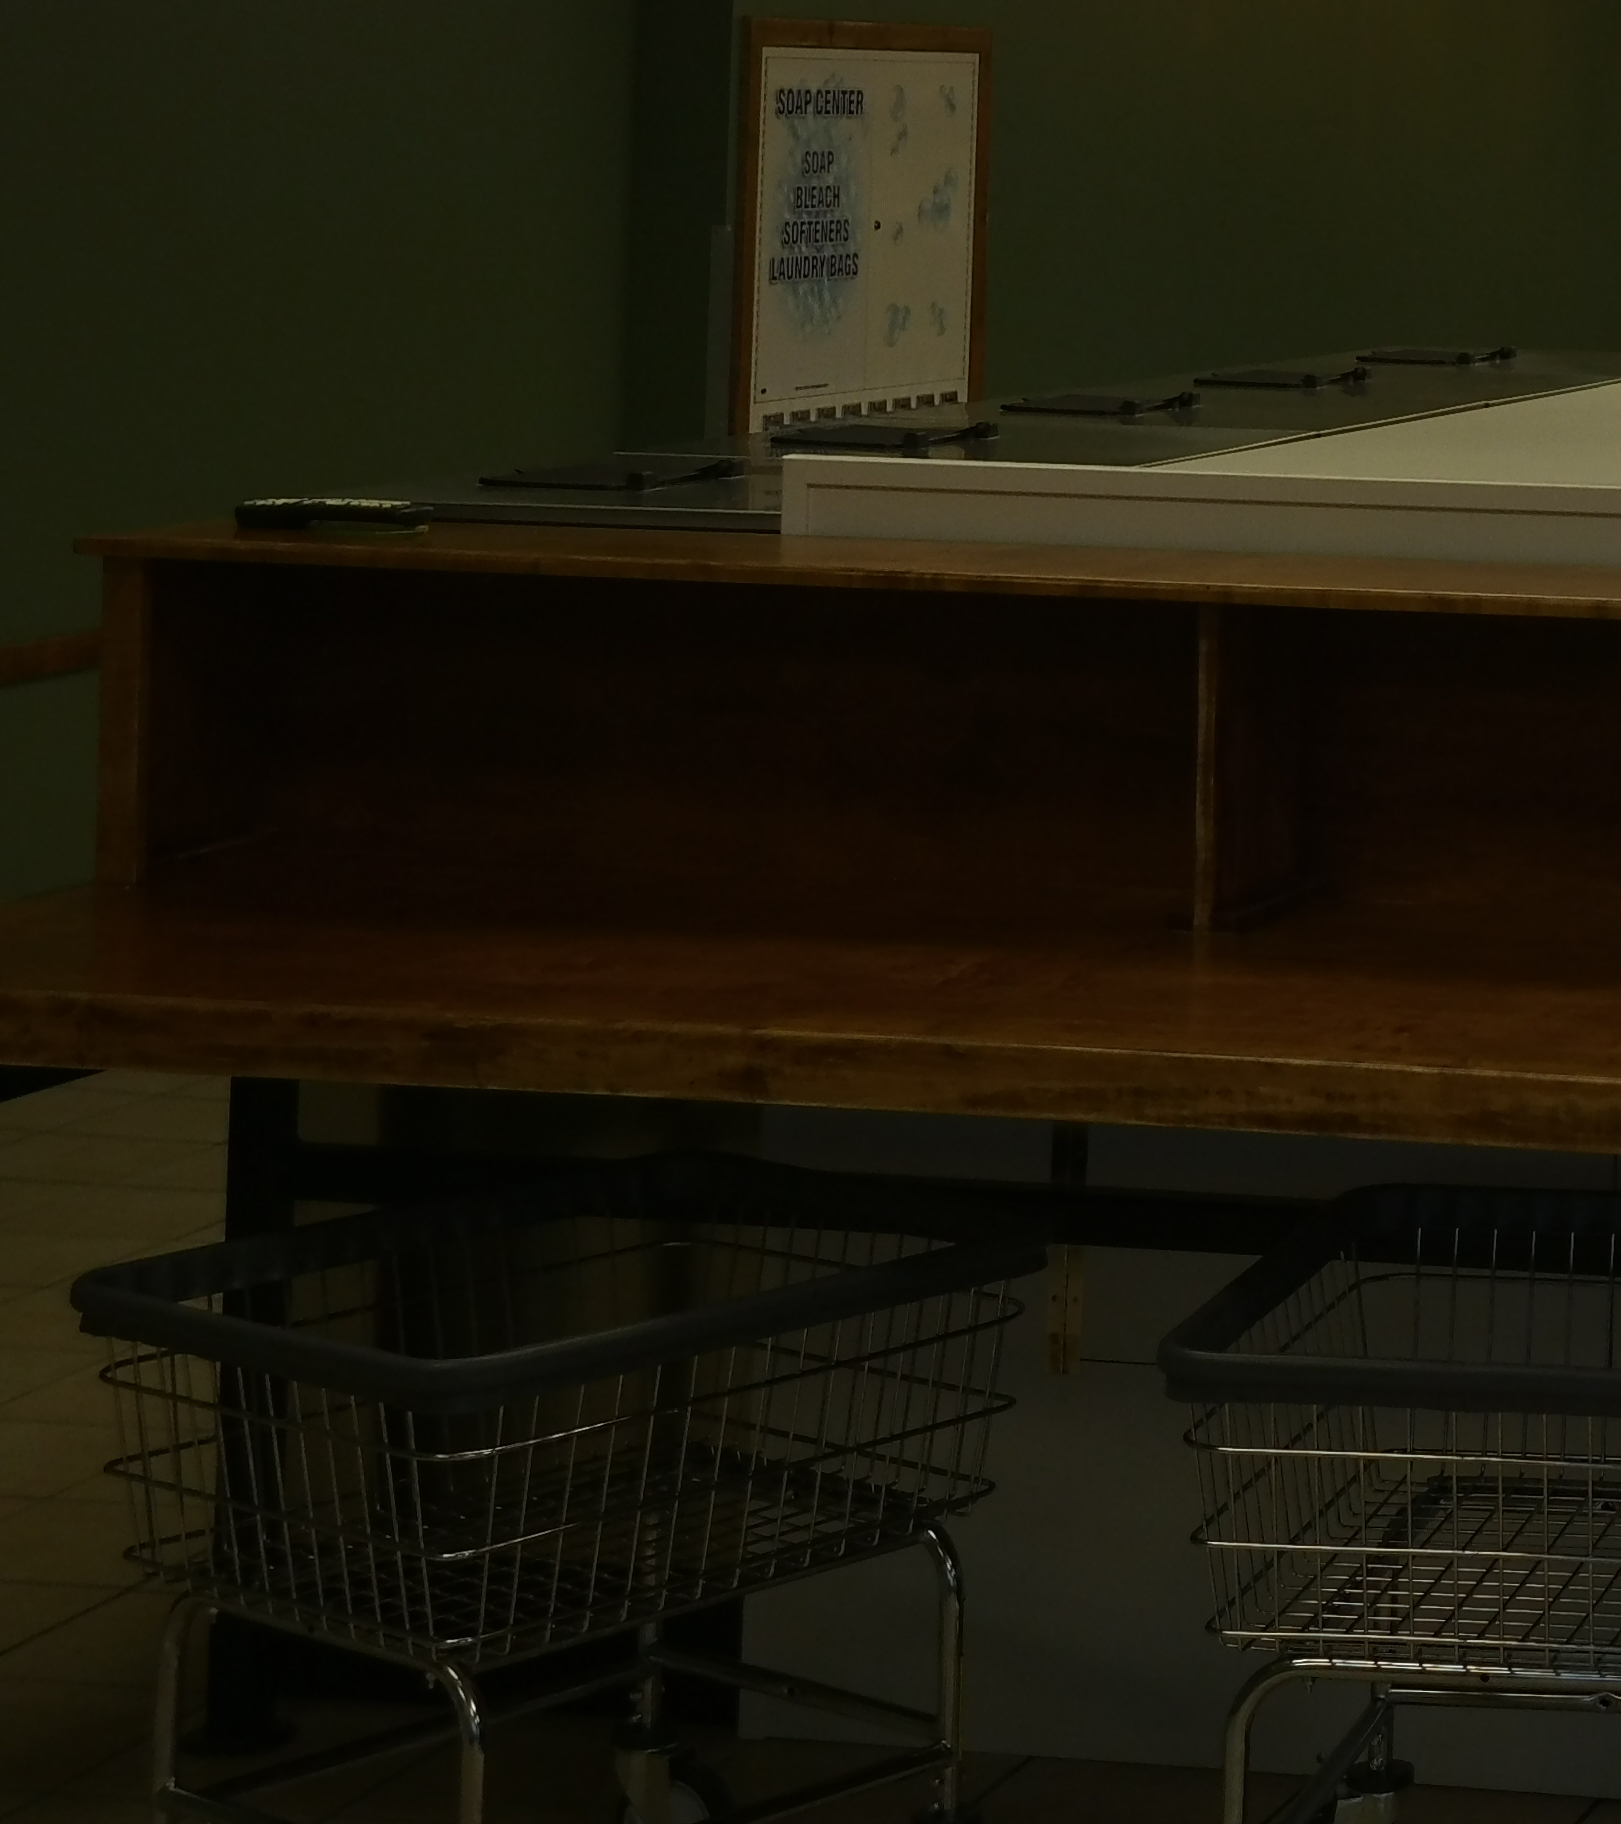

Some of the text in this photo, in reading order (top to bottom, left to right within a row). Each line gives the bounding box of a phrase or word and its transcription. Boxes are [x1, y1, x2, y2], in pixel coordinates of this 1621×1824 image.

[777, 88, 864, 115] SOAP CENTER
[804, 150, 835, 175] SOAP
[796, 185, 841, 209] BLEACH
[783, 219, 850, 245] SOFTENERS
[771, 252, 859, 281] LAUNDRY BAGS
